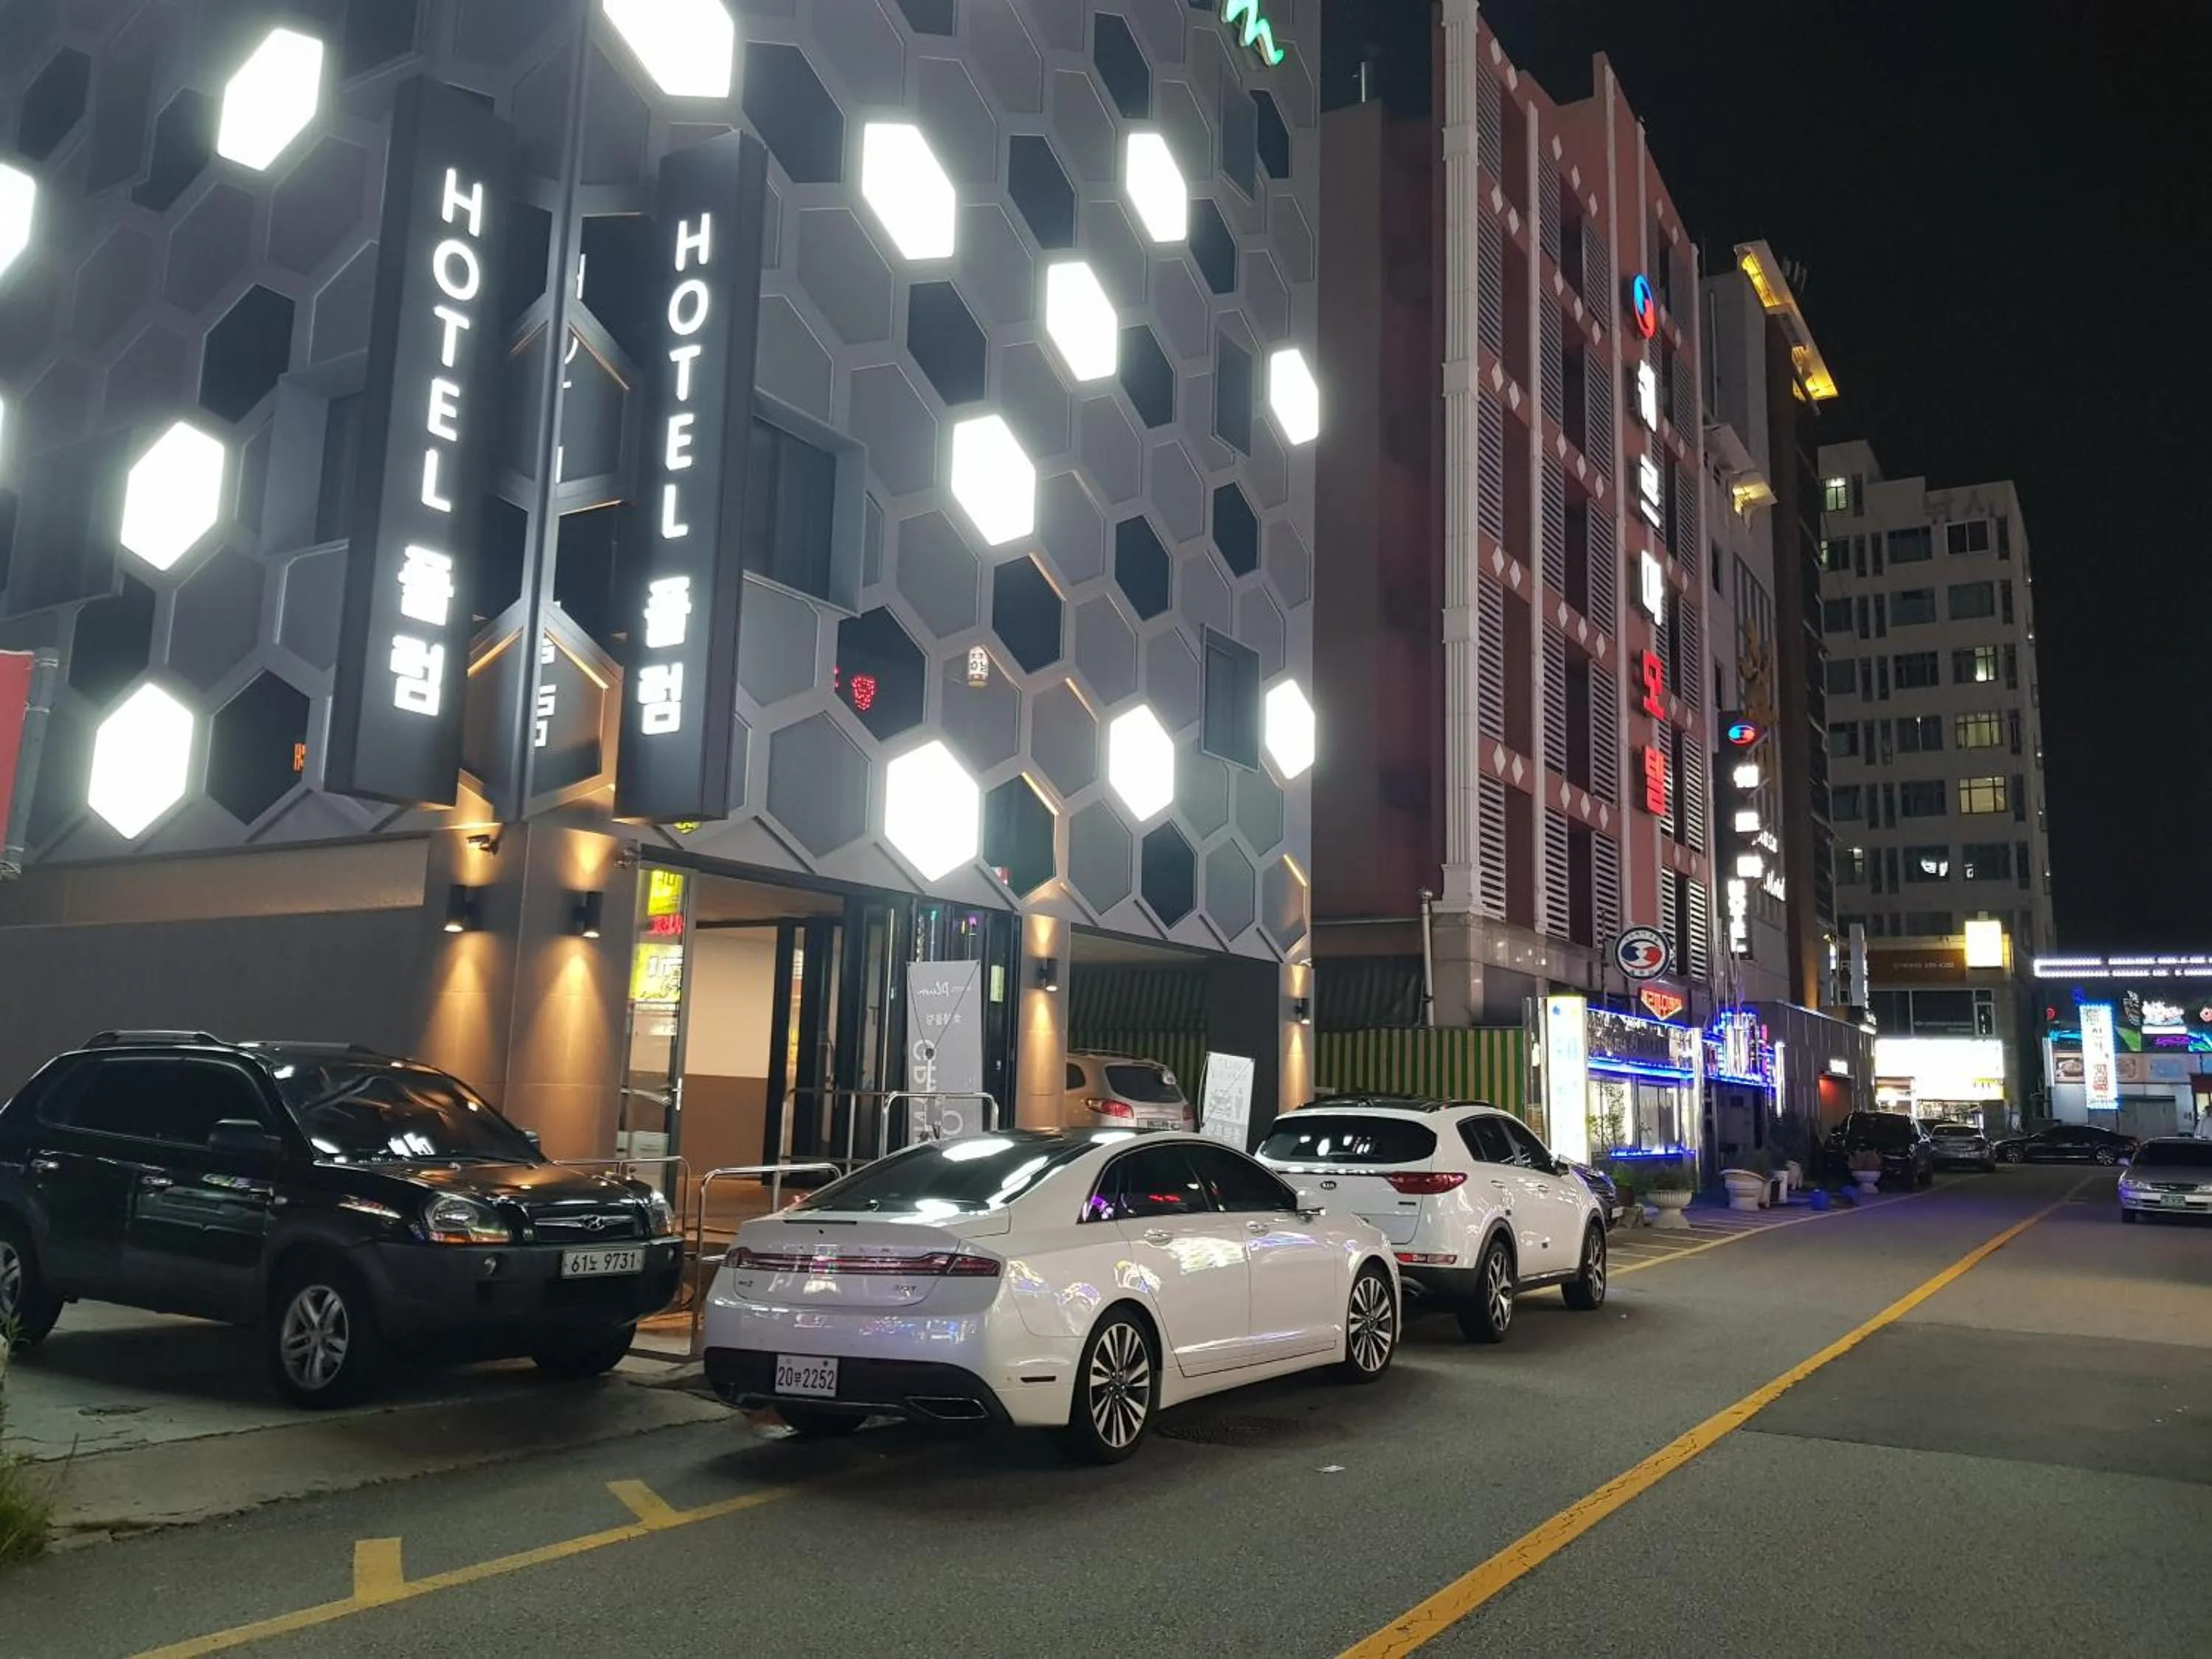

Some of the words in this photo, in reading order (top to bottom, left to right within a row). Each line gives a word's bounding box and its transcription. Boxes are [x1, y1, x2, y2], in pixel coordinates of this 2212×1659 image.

[420, 167, 483, 512] HOTEL
[661, 212, 711, 539] HOTEL
[603, 1252, 636, 1270] 9731
